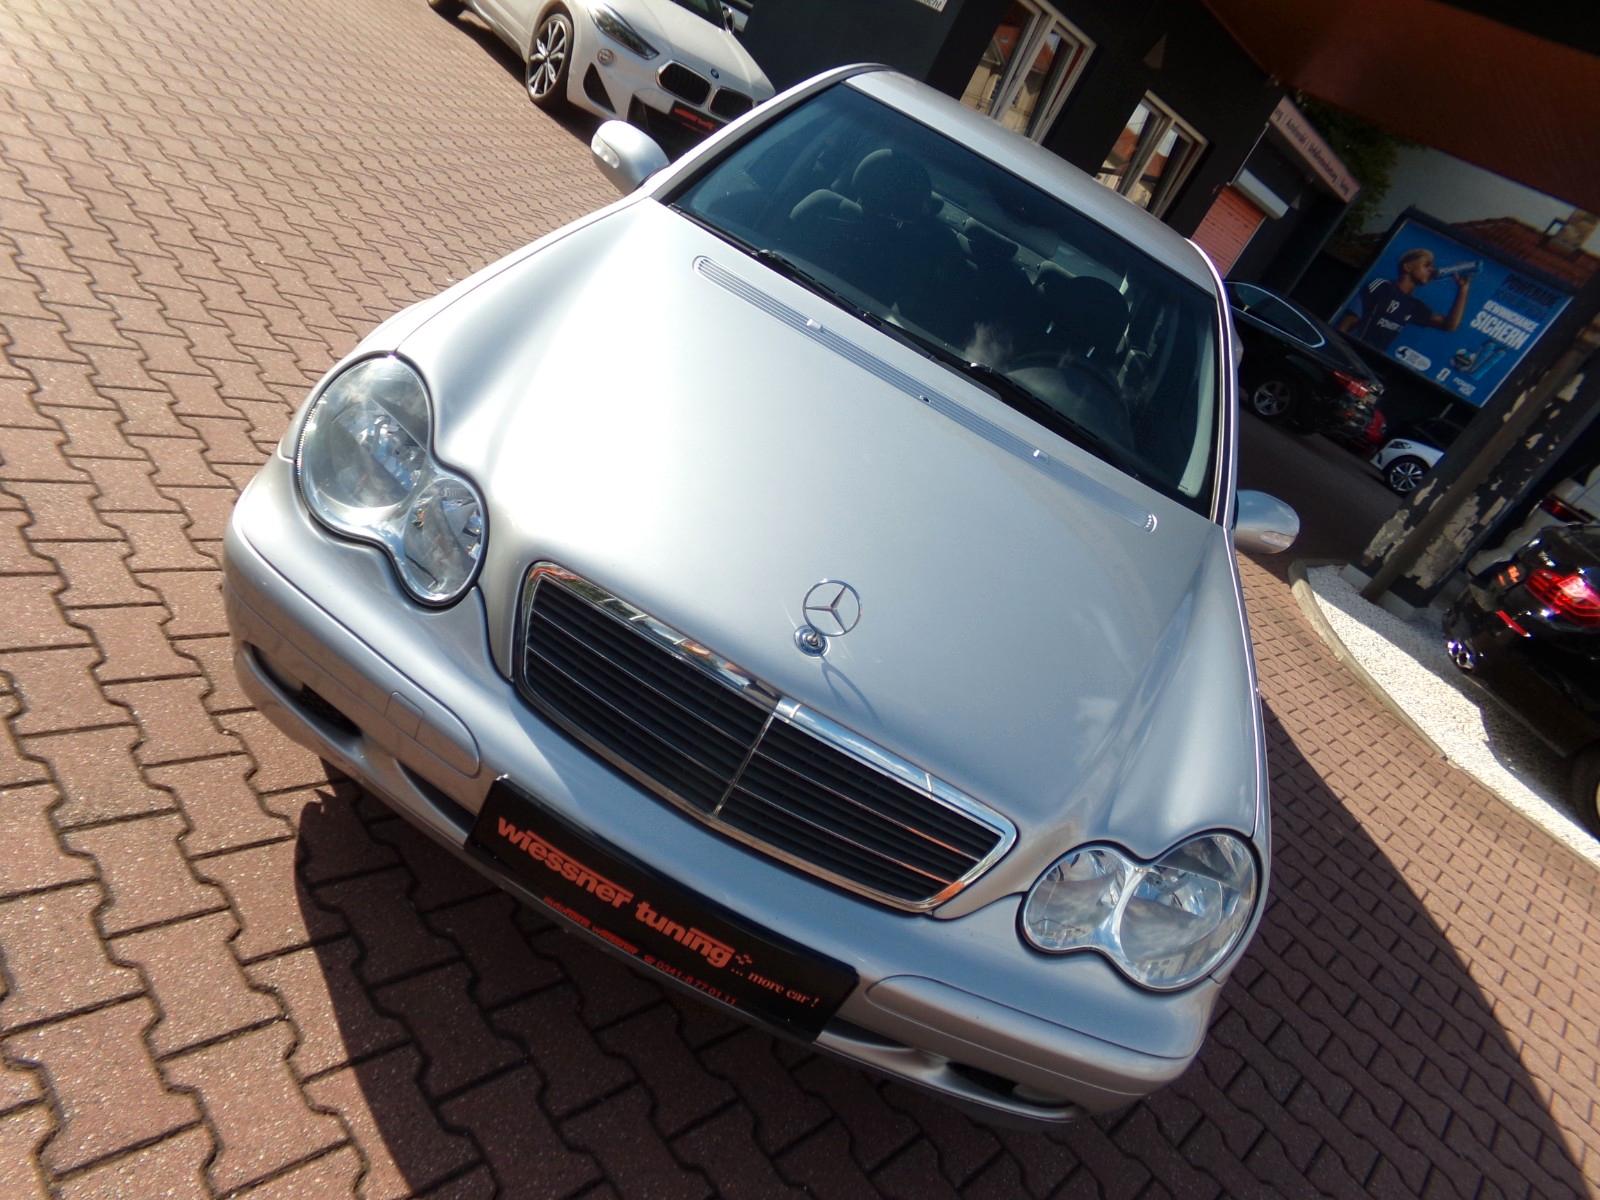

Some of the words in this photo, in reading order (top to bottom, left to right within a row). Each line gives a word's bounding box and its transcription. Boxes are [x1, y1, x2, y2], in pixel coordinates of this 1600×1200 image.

[1470, 310, 1531, 350] SICHERN
[498, 816, 634, 909] wiessner
[634, 901, 736, 969] tuning
[747, 972, 785, 994] more
[786, 989, 812, 1006] car
